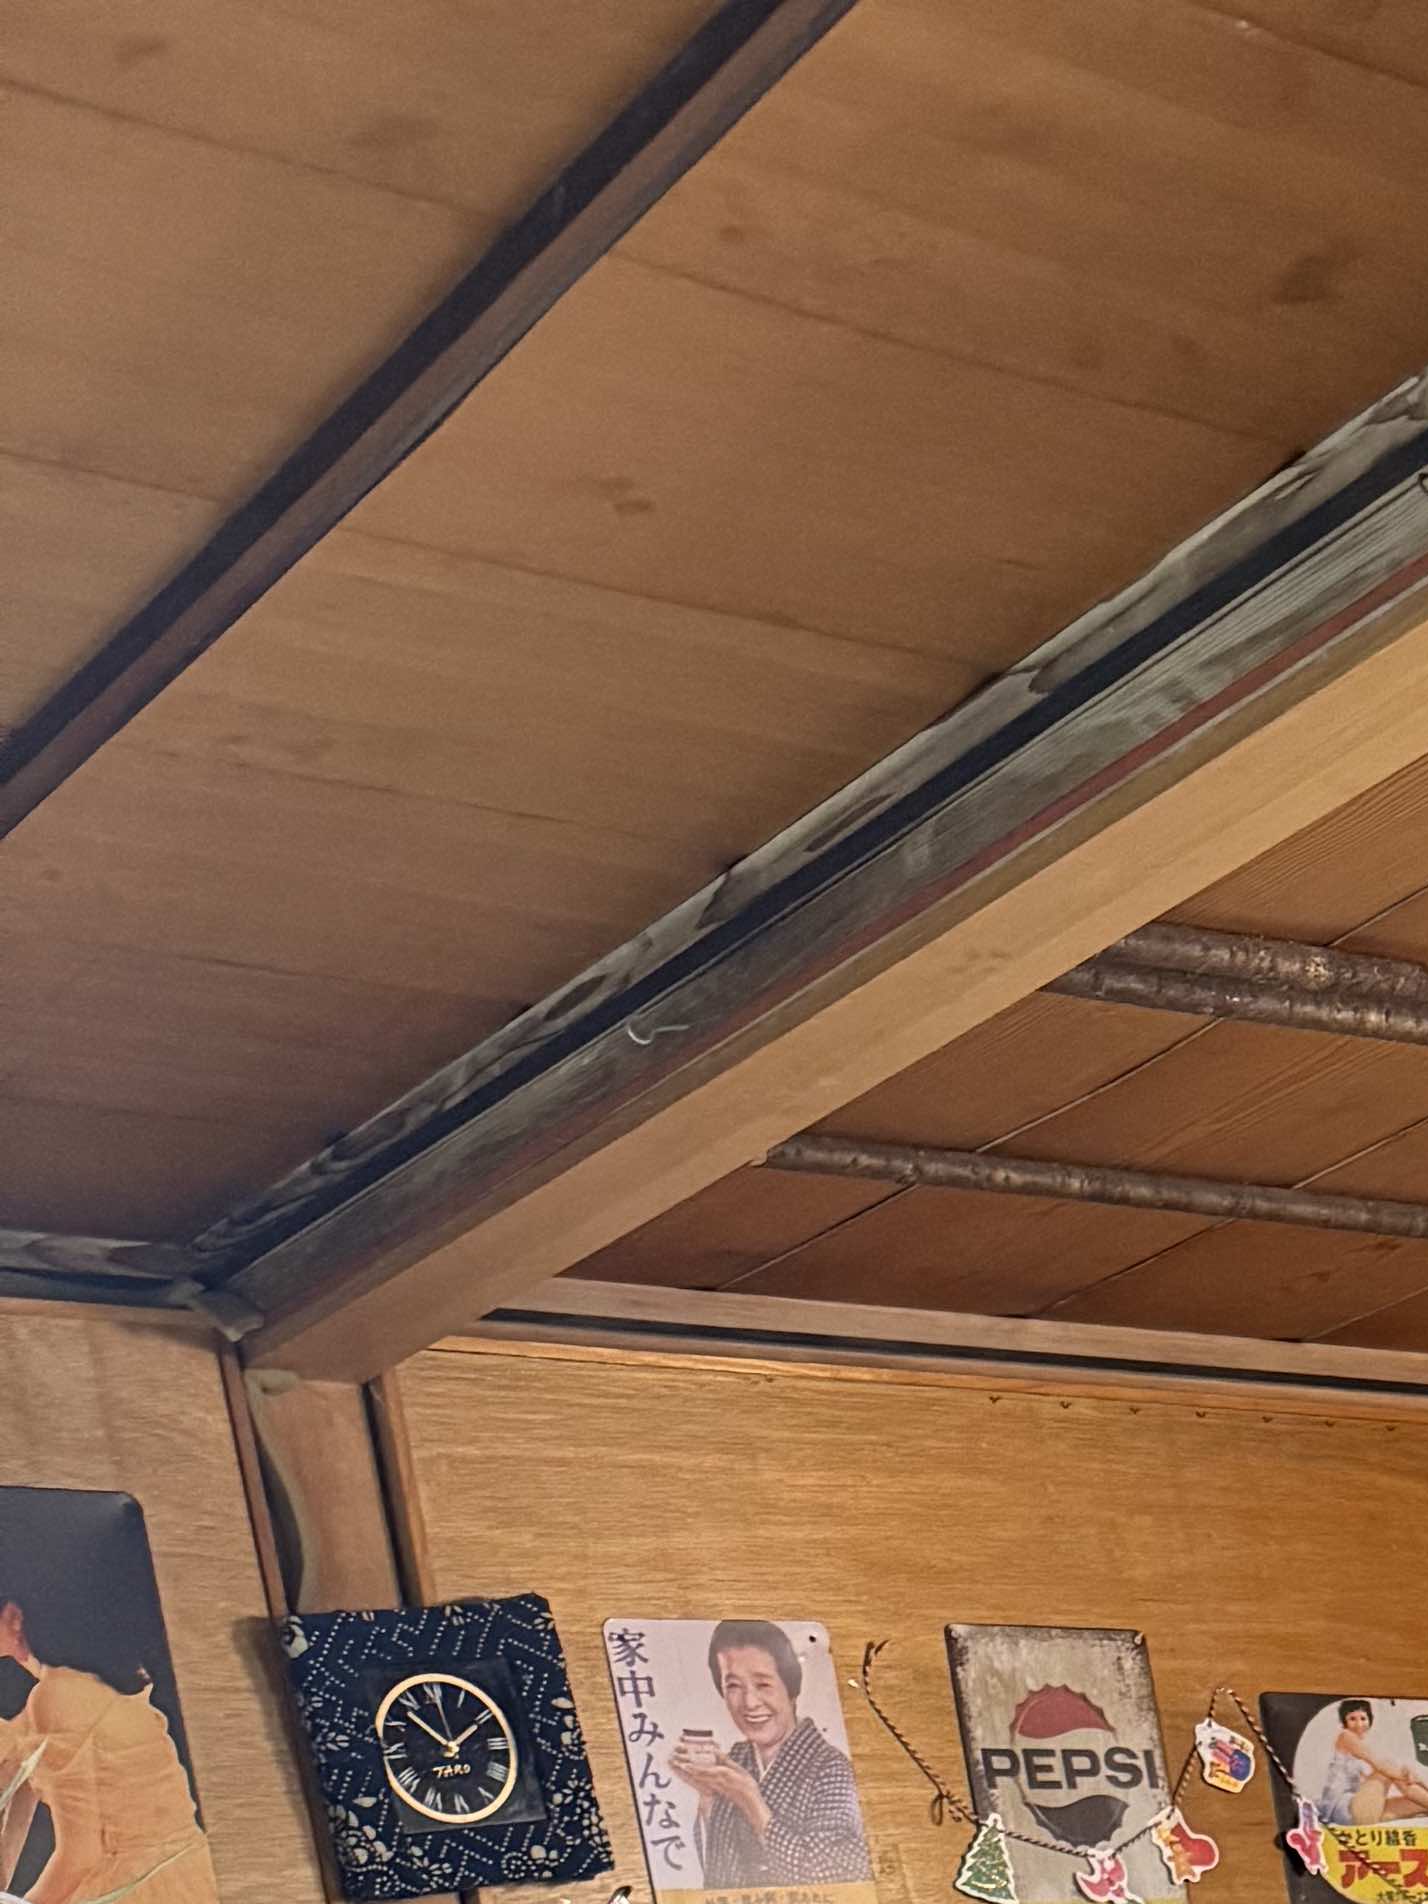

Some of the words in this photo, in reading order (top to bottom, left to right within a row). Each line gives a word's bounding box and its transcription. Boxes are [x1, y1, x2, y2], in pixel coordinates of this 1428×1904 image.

[606, 1627, 688, 1872] 家中みんなで
[980, 1745, 1160, 1793] PEPSI
